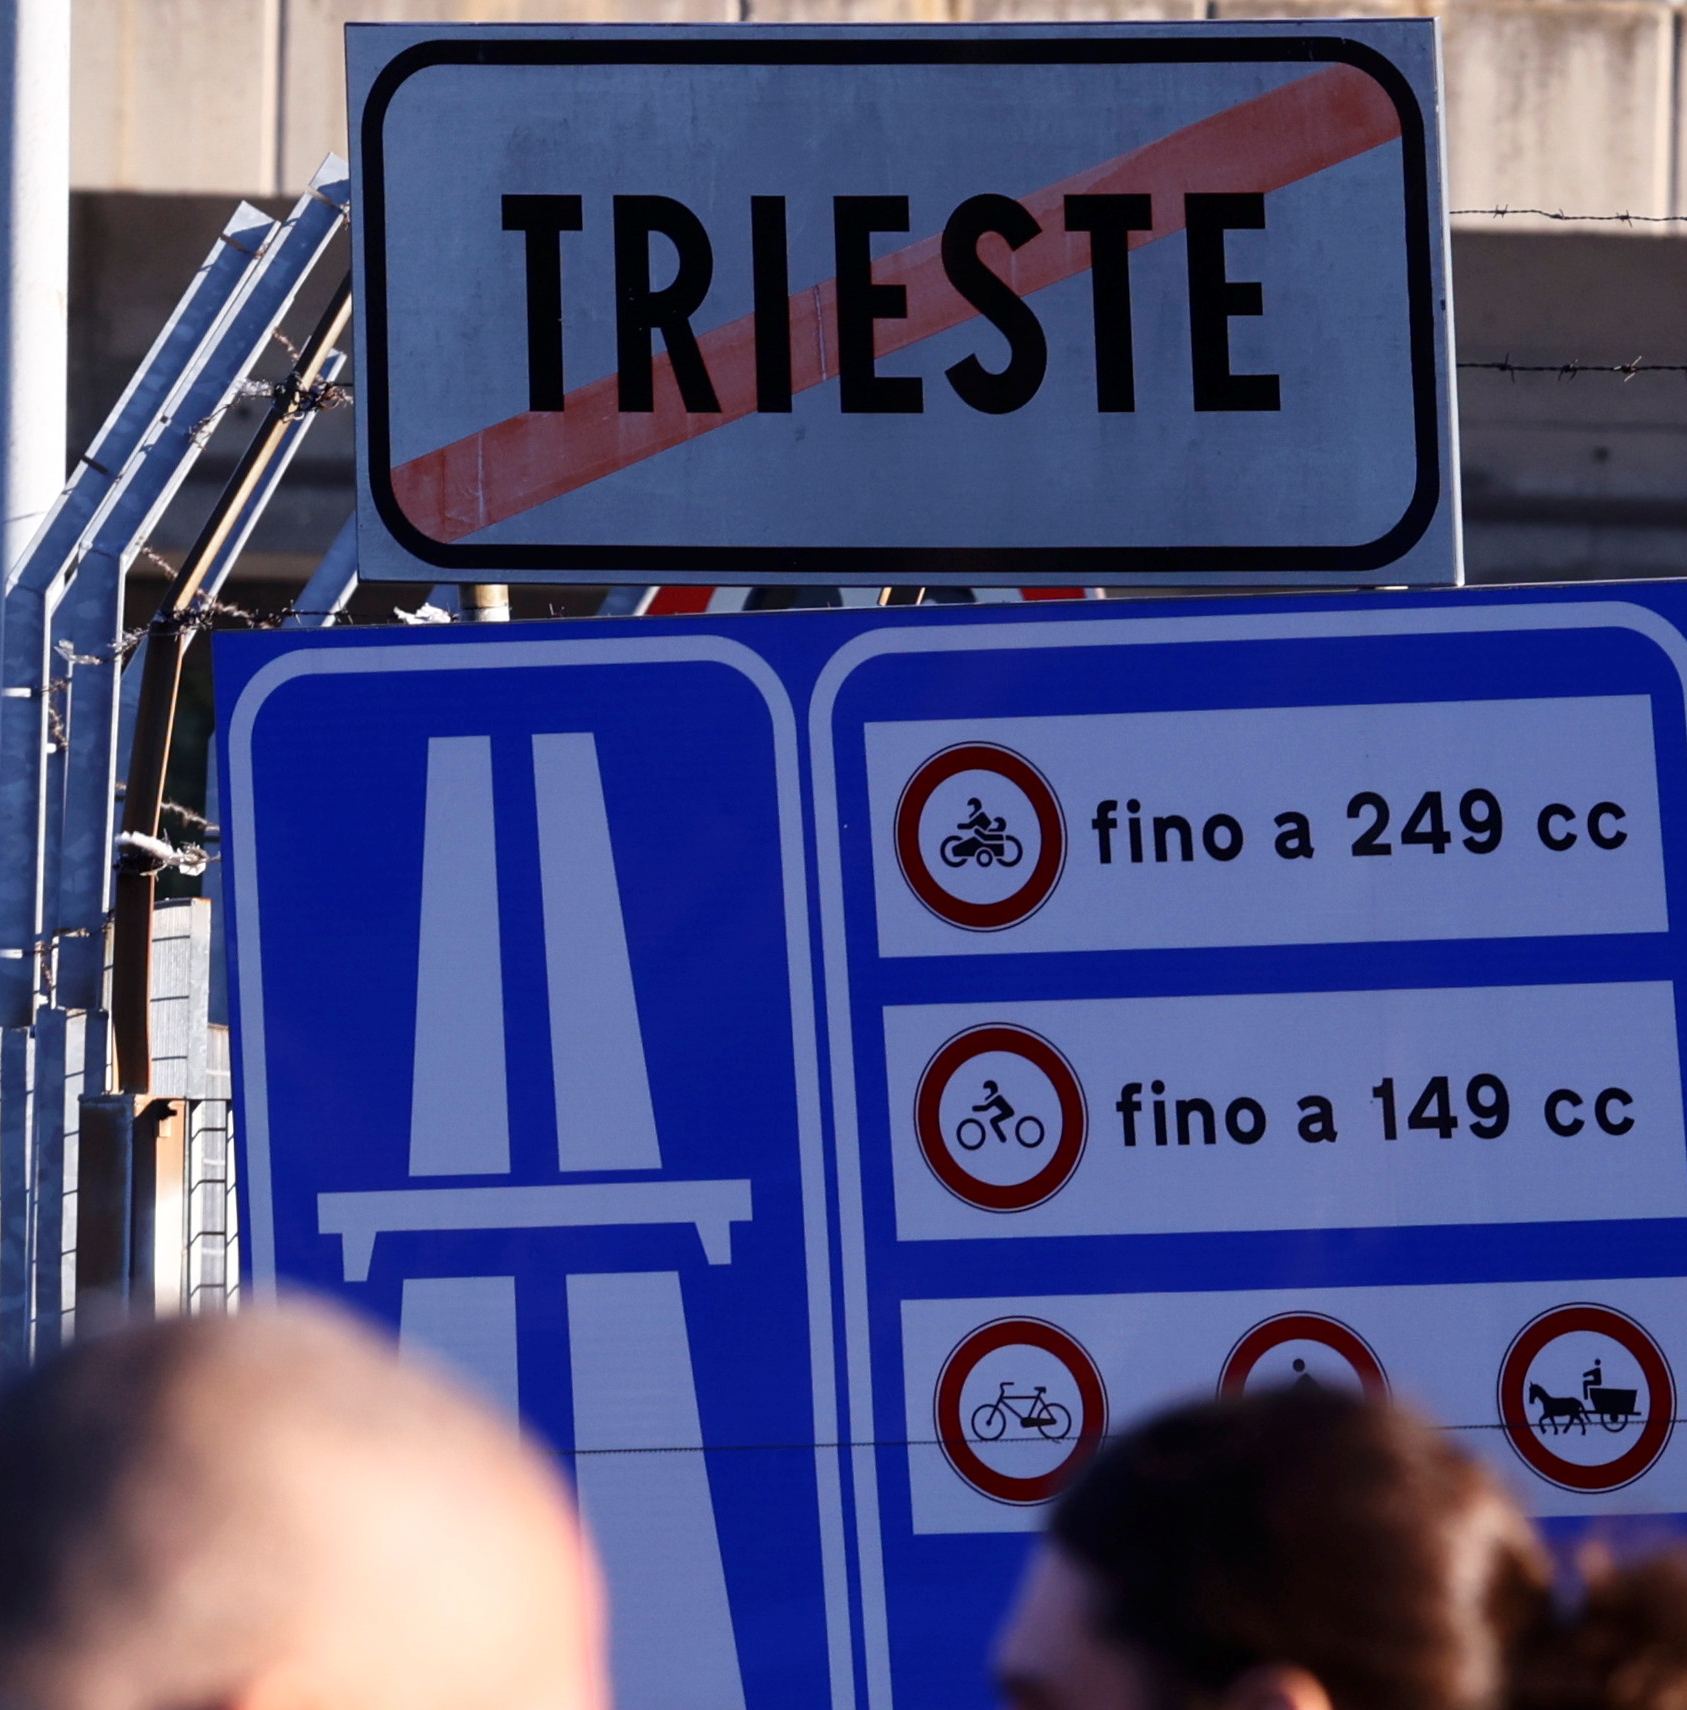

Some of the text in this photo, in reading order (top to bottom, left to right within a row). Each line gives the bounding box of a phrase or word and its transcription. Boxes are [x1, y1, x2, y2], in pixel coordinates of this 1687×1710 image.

[500, 192, 1282, 415] TRIESTE
[1092, 788, 1628, 864] fino a 249 cc
[1115, 1073, 1635, 1147] fino a 149 cc
